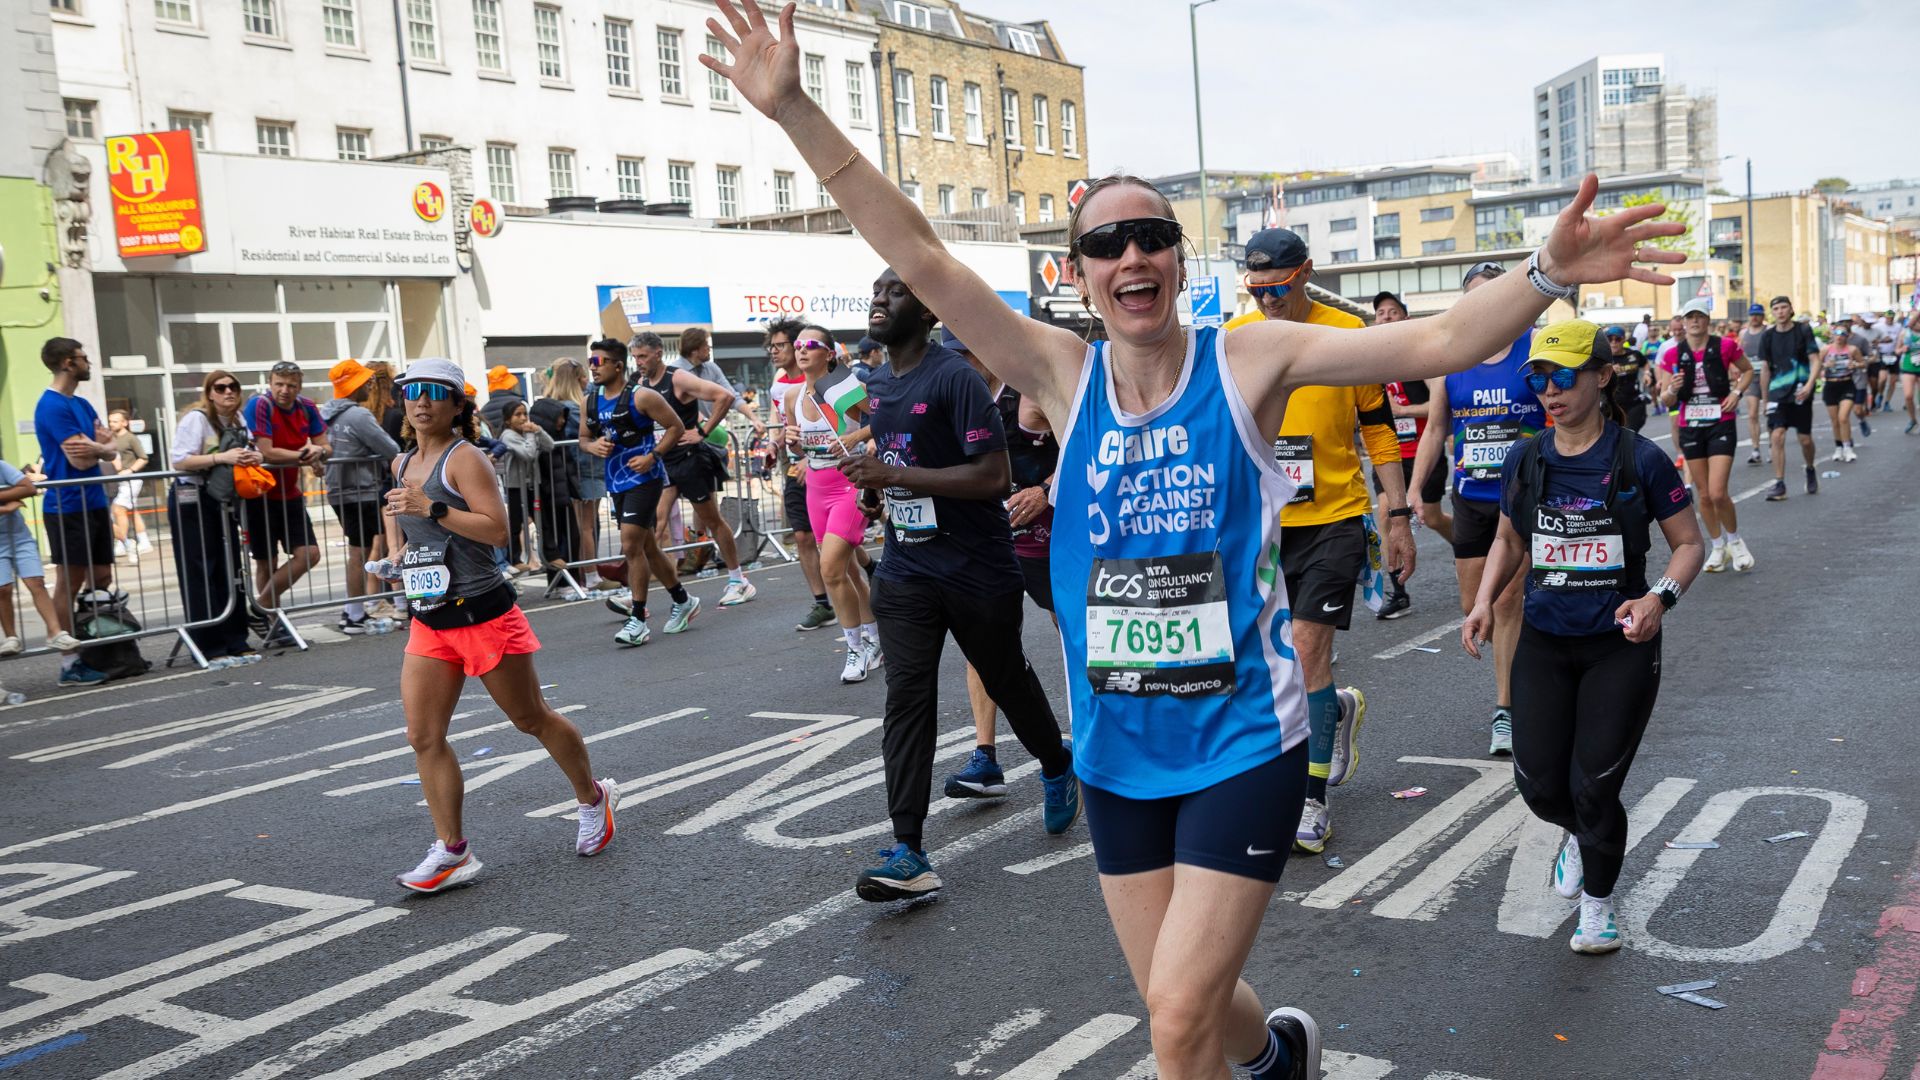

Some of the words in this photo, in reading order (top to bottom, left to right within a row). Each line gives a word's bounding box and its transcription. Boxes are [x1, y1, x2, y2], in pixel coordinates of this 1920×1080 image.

[106, 136, 166, 194] RH
[118, 204, 138, 215] ALL
[417, 185, 444, 216] RH
[472, 205, 494, 232] RH
[289, 226, 317, 238] River
[320, 227, 356, 240] Habitat
[358, 228, 380, 241] Real
[382, 230, 411, 242] Estate
[414, 230, 449, 243] Brokers
[241, 249, 300, 262] Residential
[303, 250, 322, 262] and
[324, 250, 383, 264] Commercial
[386, 252, 410, 264] Sales
[412, 252, 430, 264] and
[431, 254, 450, 265] Lets
[744, 296, 804, 314] TESCO
[810, 292, 870, 319] express
[1472, 388, 1512, 406] PAUL
[1510, 403, 1538, 415] Care
[1466, 426, 1486, 441] tcs
[1098, 424, 1189, 466] Claire
[1116, 463, 1215, 497] ACTION
[1118, 487, 1215, 518] AGAINST
[1118, 509, 1216, 537] HUNGER
[1537, 508, 1564, 533] tcs
[1566, 518, 1613, 528] CONSULTANCY
[1566, 526, 1598, 534] SERVICES
[404, 549, 418, 565] tcs
[1544, 542, 1608, 564] 21775
[1145, 565, 1171, 576] TATA
[1542, 571, 1568, 586] NB
[410, 571, 441, 591] 61093
[1094, 567, 1144, 599] tcs
[1148, 572, 1214, 588] CONSULTANCY
[1584, 578, 1618, 587] balance
[1146, 586, 1188, 600] SERVICES
[1106, 618, 1203, 655] 76951
[1104, 671, 1142, 693] NB
[1144, 682, 1169, 692] new
[1170, 678, 1222, 694] balance
